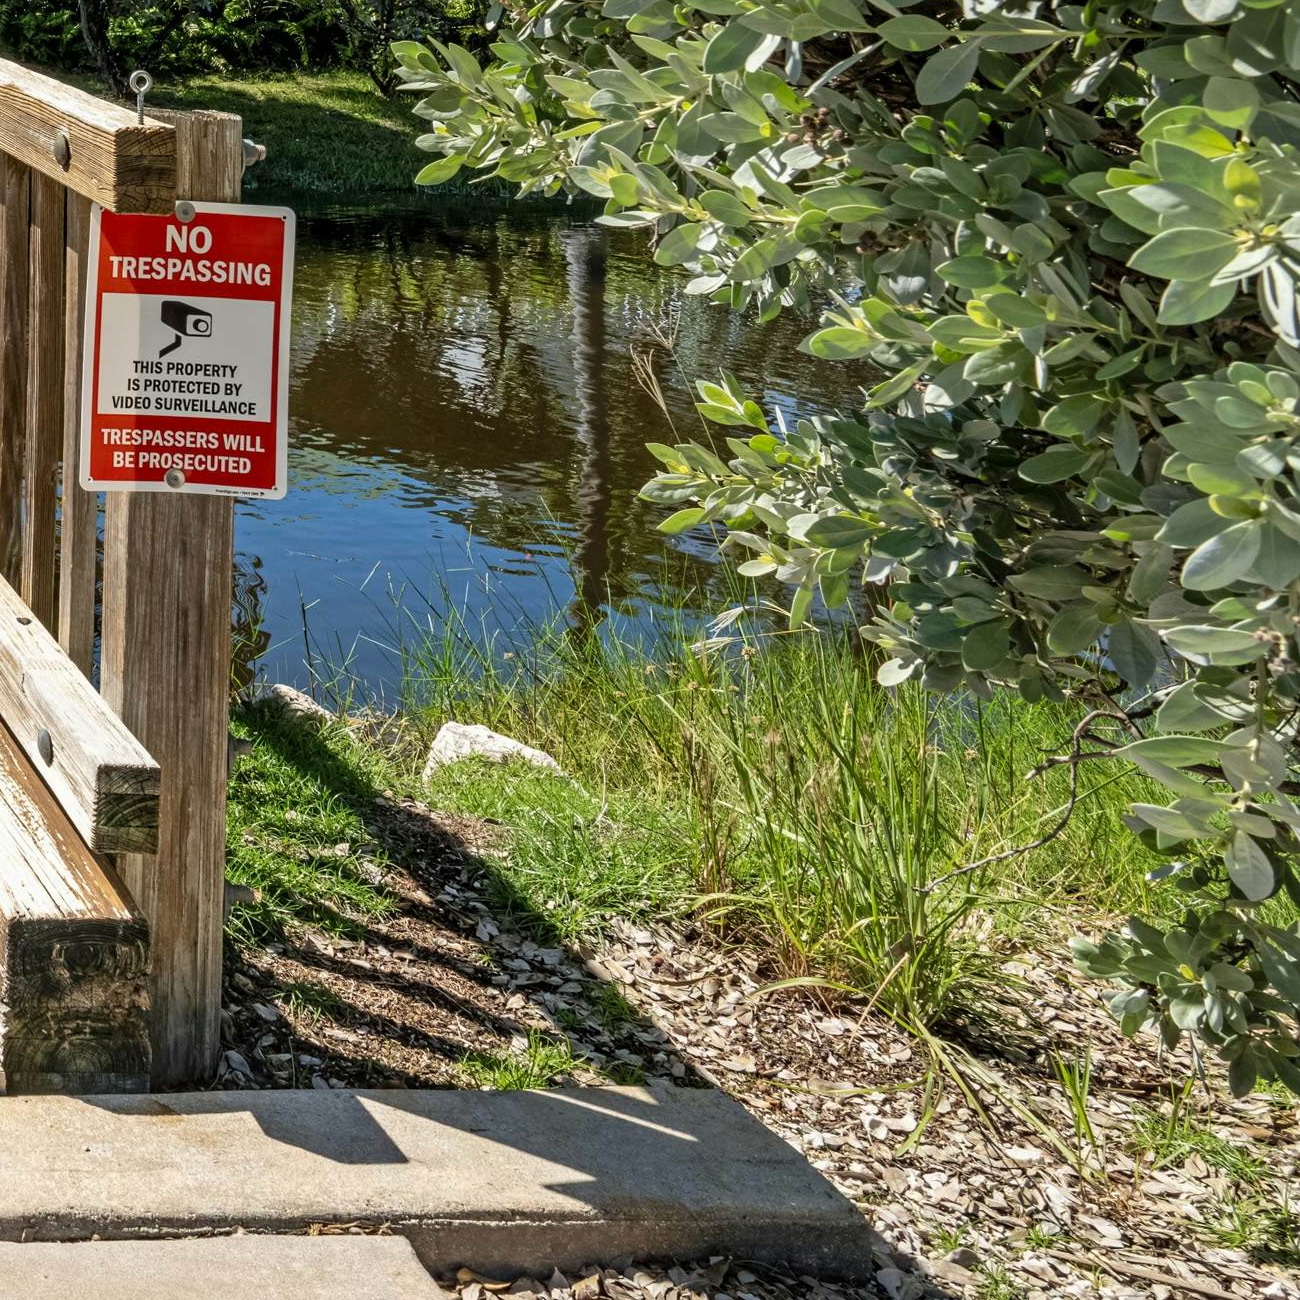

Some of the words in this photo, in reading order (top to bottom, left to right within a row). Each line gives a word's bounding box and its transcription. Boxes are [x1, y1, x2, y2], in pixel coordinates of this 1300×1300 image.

[166, 225, 212, 254] NO
[110, 256, 271, 286] TRESPASSING
[133, 361, 163, 374] THIS
[166, 362, 237, 378] PROPERTY
[127, 379, 140, 391] IS
[144, 380, 219, 395] PROTECTED
[224, 383, 242, 396] BY
[112, 396, 151, 409] VIDEO
[154, 397, 257, 415] SURVEILLANCE
[101, 428, 219, 449] TRESPASSERS
[223, 434, 265, 452] WILL
[113, 452, 135, 468] BE
[138, 454, 251, 474] PROSECUTED
